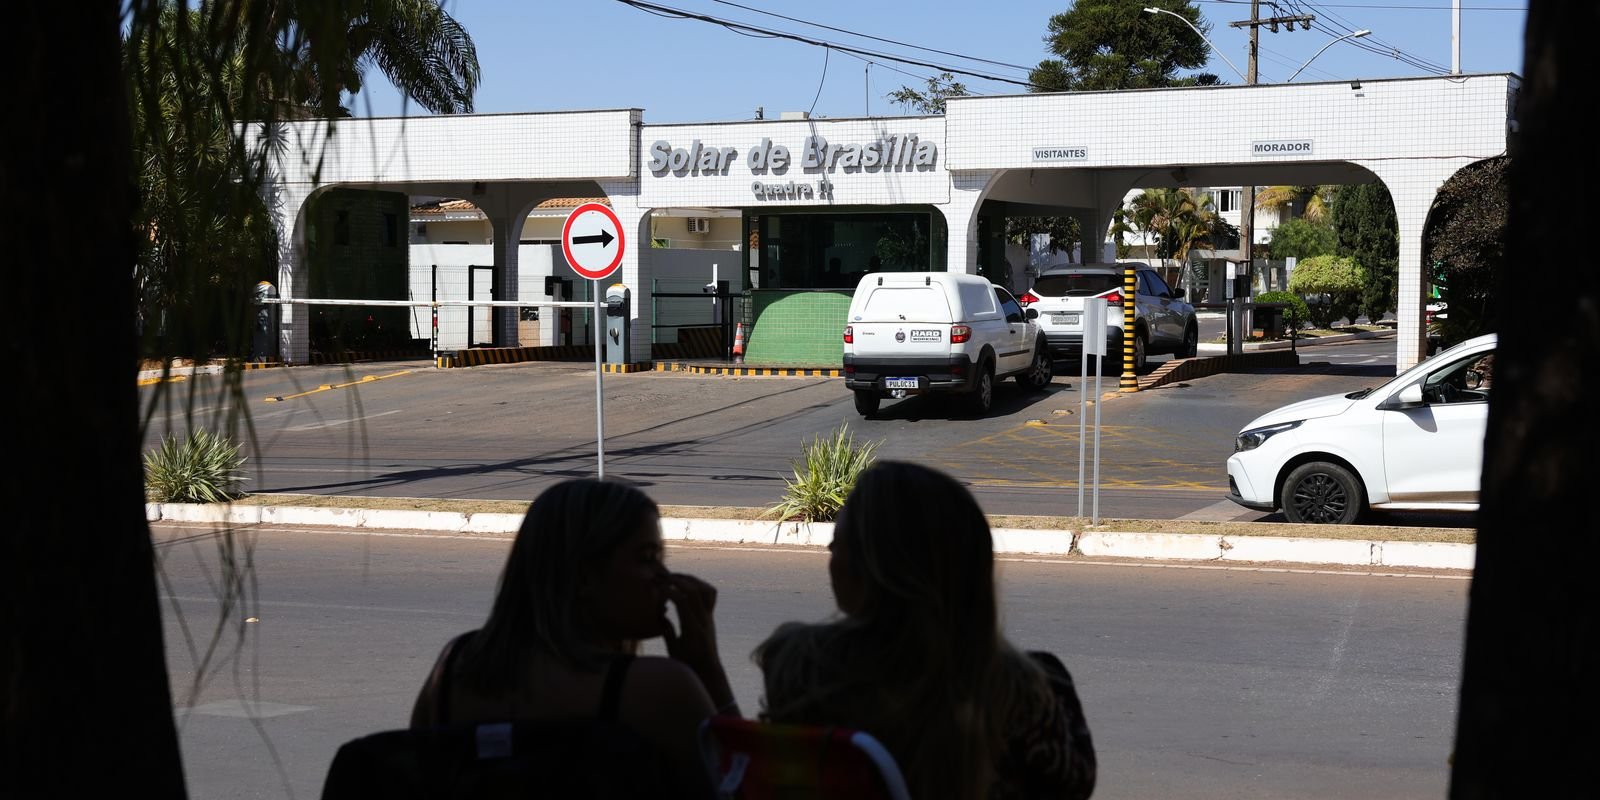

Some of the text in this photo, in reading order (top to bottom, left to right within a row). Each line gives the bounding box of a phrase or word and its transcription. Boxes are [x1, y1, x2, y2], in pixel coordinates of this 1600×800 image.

[648, 133, 938, 175] Solar de Brasília
[1034, 148, 1086, 160] VISITANTES
[1253, 142, 1311, 154] MORADOR
[751, 180, 811, 197] Quadra
